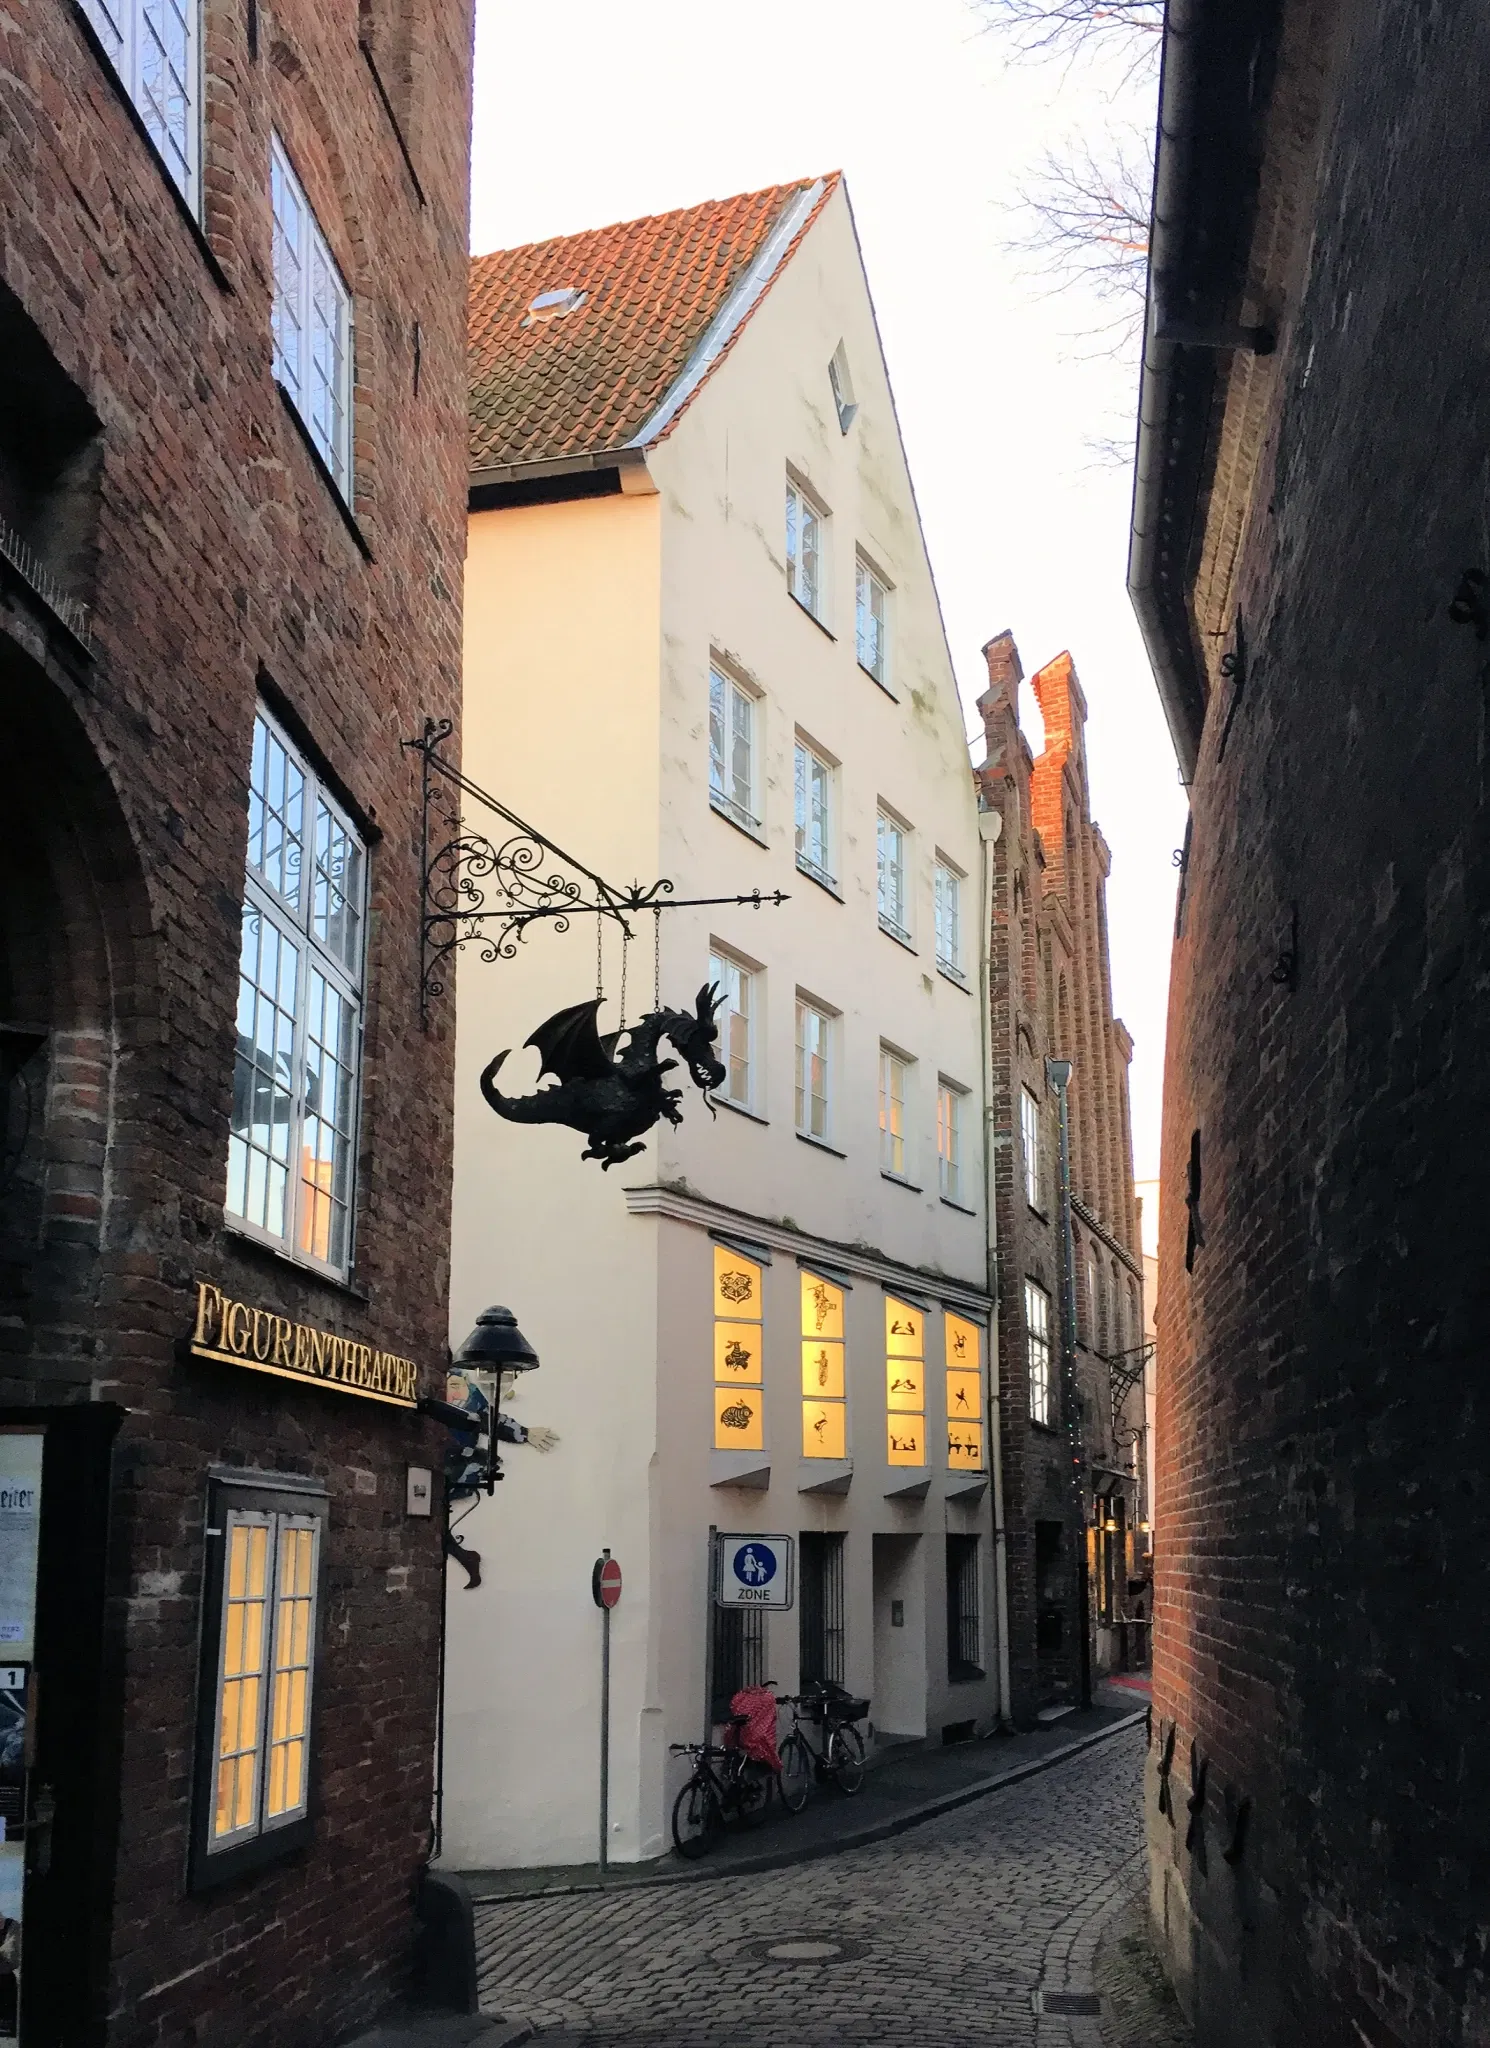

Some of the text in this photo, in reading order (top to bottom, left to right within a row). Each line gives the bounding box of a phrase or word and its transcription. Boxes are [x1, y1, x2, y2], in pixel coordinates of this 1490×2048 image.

[192, 1280, 418, 1400] FIGURENTHEATER
[738, 1588, 771, 1601] ZONE
[8, 1671, 16, 1685] 1
